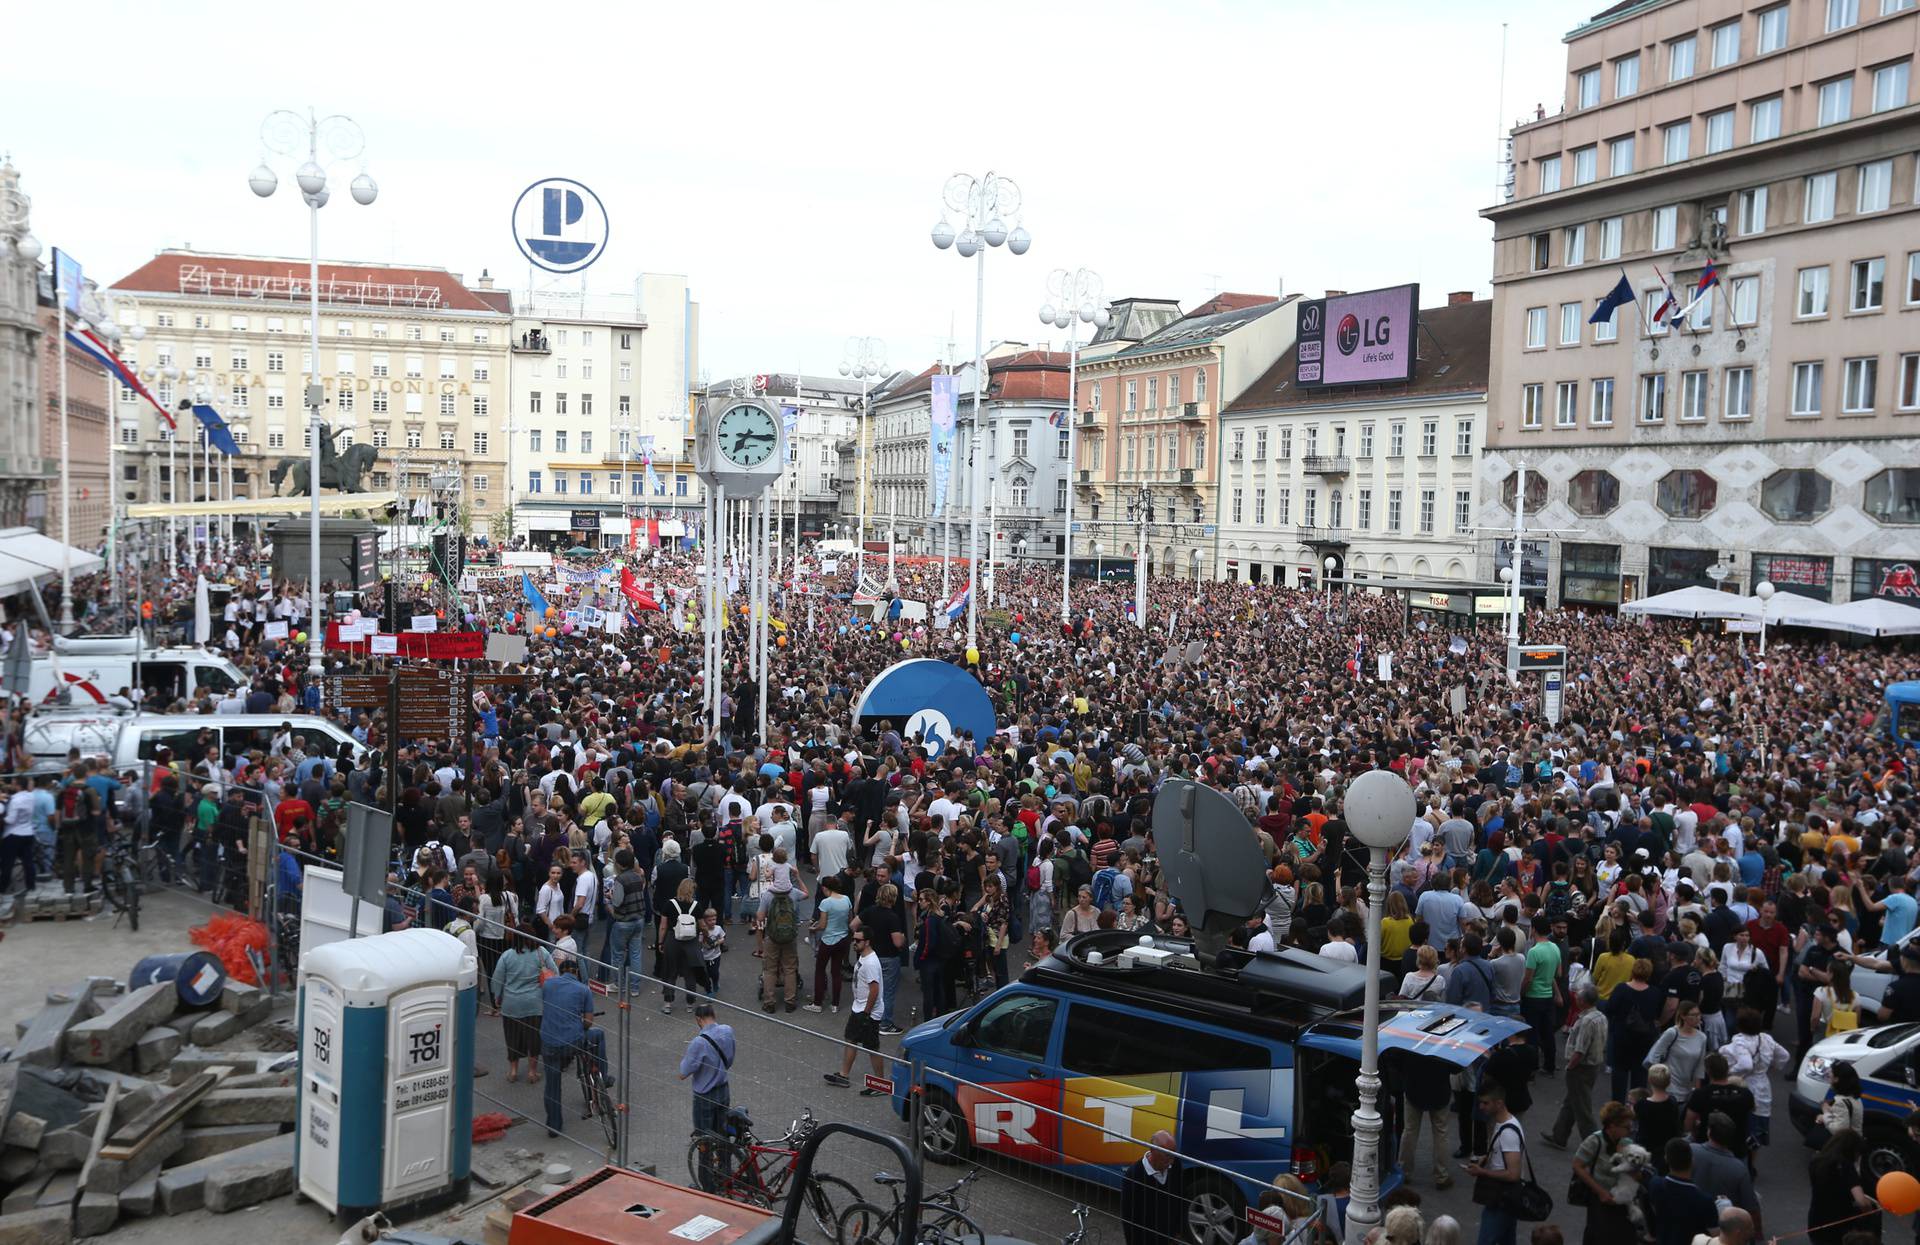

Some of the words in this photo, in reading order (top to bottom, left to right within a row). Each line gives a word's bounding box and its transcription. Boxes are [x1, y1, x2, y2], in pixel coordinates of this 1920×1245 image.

[1363, 315, 1391, 347] LG
[1362, 353, 1378, 363] Life's
[1378, 351, 1394, 362] Good
[1429, 596, 1450, 607] TISAK
[314, 1043, 331, 1064] TOI
[409, 1046, 440, 1064] TOI
[974, 1088, 1286, 1145] RTL
